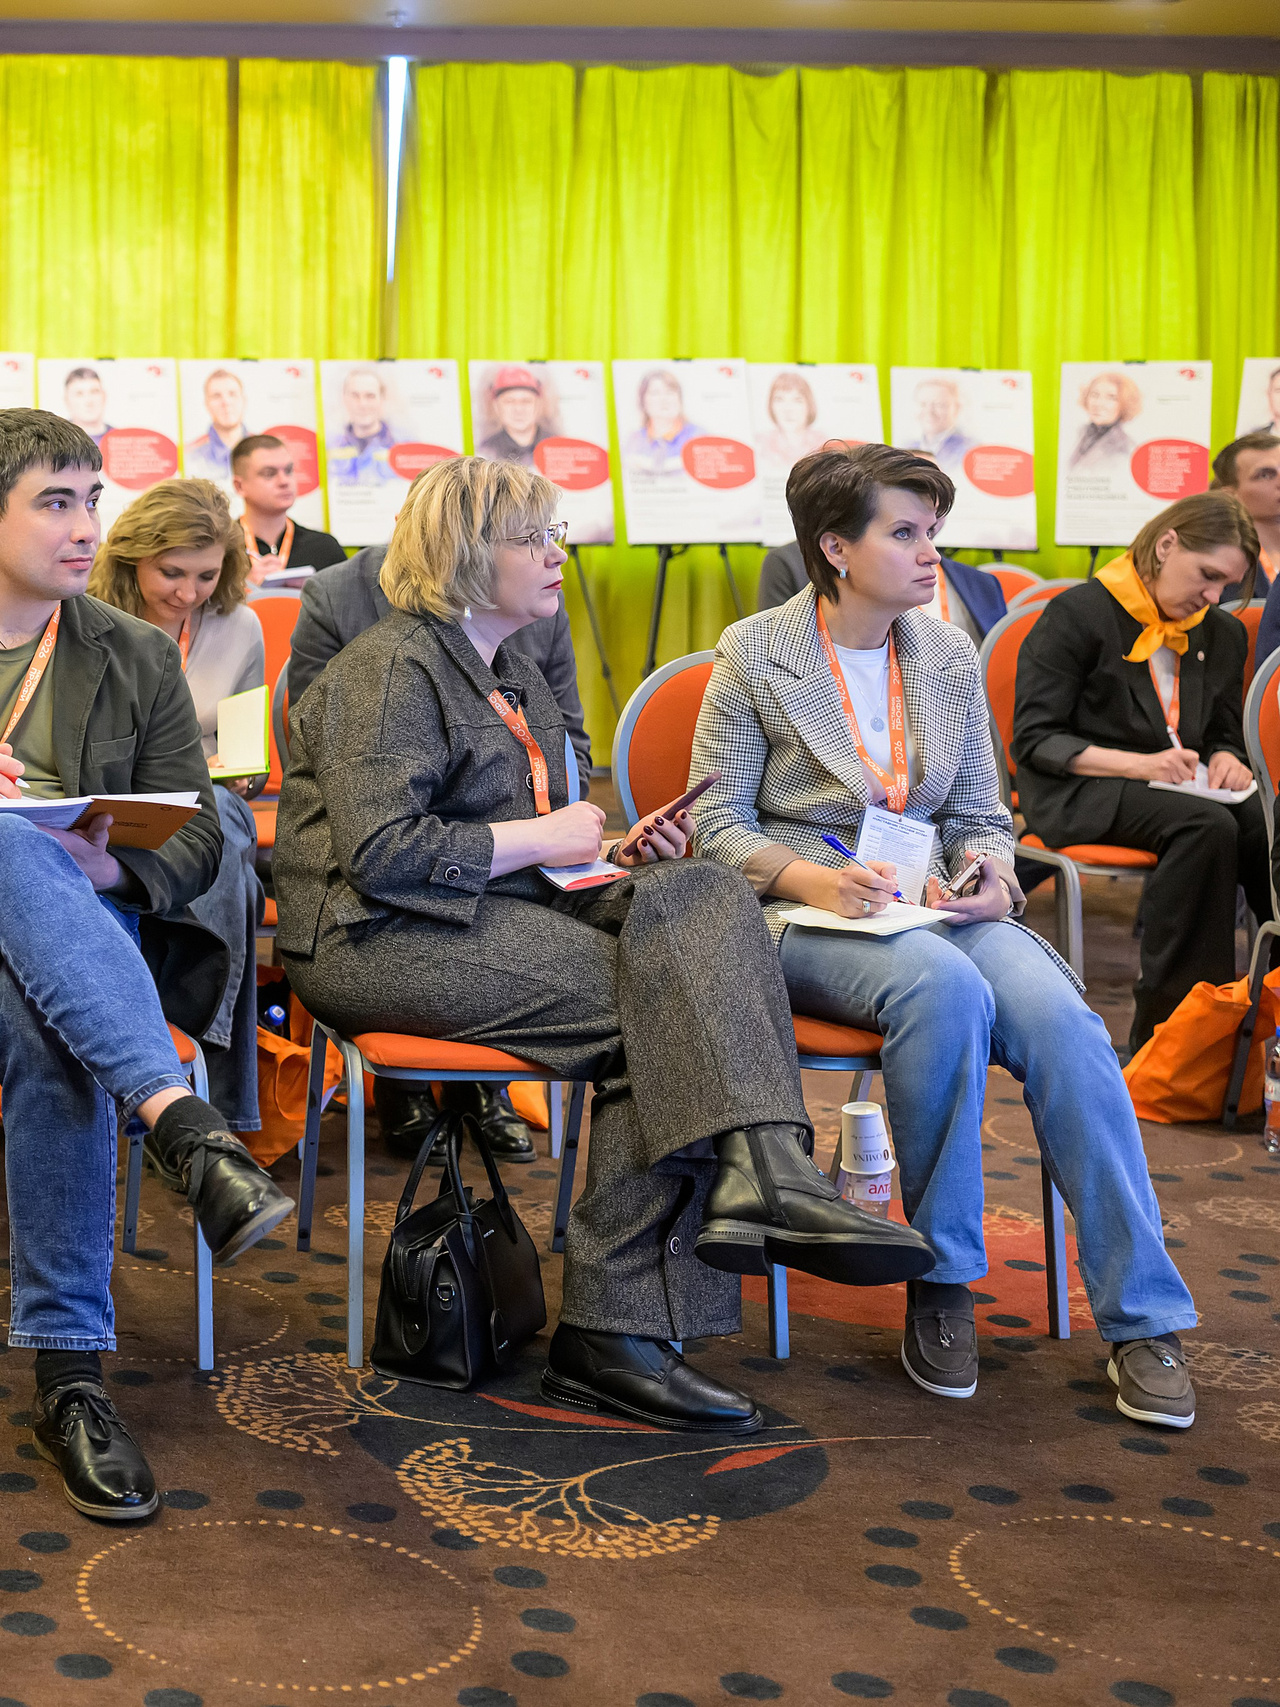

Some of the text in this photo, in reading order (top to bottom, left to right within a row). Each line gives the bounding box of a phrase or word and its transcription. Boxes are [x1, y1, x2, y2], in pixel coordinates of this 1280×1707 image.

[38, 631, 55, 659] 2026
[818, 631, 832, 665] ПРОФИ
[822, 629, 837, 663] НАСТАВНИК
[20, 666, 38, 702] ПРОФИ
[834, 674, 848, 703] 2026
[488, 692, 508, 717] ОФИ
[494, 690, 510, 713] ТАВНИК
[511, 722, 534, 747] 2026
[844, 713, 860, 748] ПРОФИ
[863, 755, 885, 778] 2026
[894, 740, 905, 765] 2026
[534, 757, 543, 792] ПРОФИ
